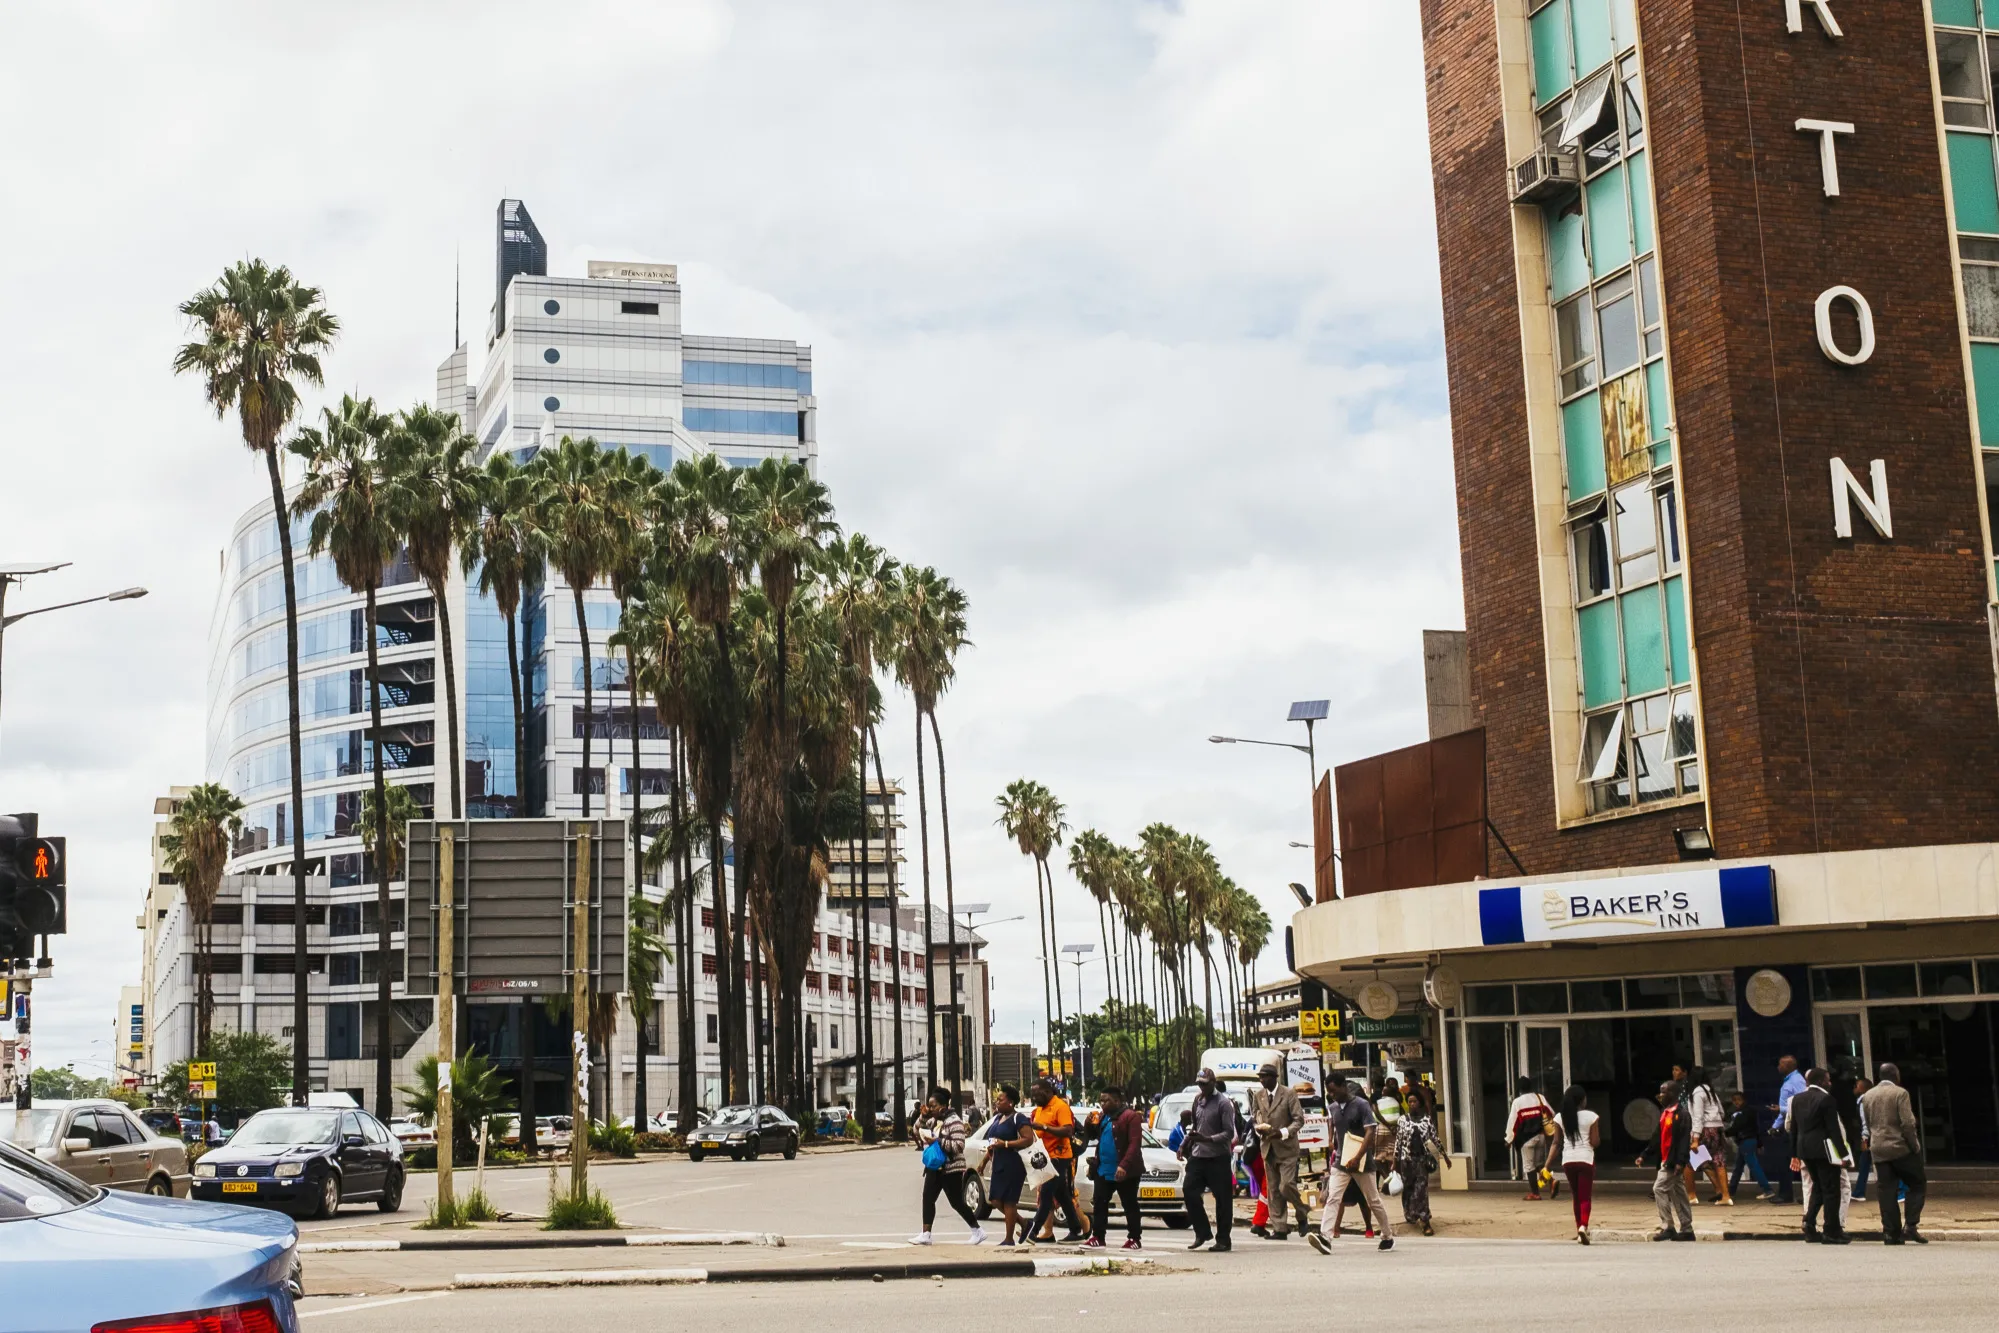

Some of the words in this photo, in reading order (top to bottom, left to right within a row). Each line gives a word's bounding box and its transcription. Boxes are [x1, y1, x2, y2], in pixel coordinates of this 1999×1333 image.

[628, 269, 648, 277] ERNST
[652, 271, 675, 279] YOUNG
[1570, 890, 1689, 918] BAKER'S
[1659, 911, 1700, 928] INN
[1323, 1013, 1338, 1027] $1
[1358, 1021, 1382, 1032] Nissi
[204, 1064, 214, 1075] $1
[1218, 1062, 1259, 1071] SWIFT
[1299, 1065, 1310, 1074] MR
[1289, 1067, 1316, 1084] BURGER
